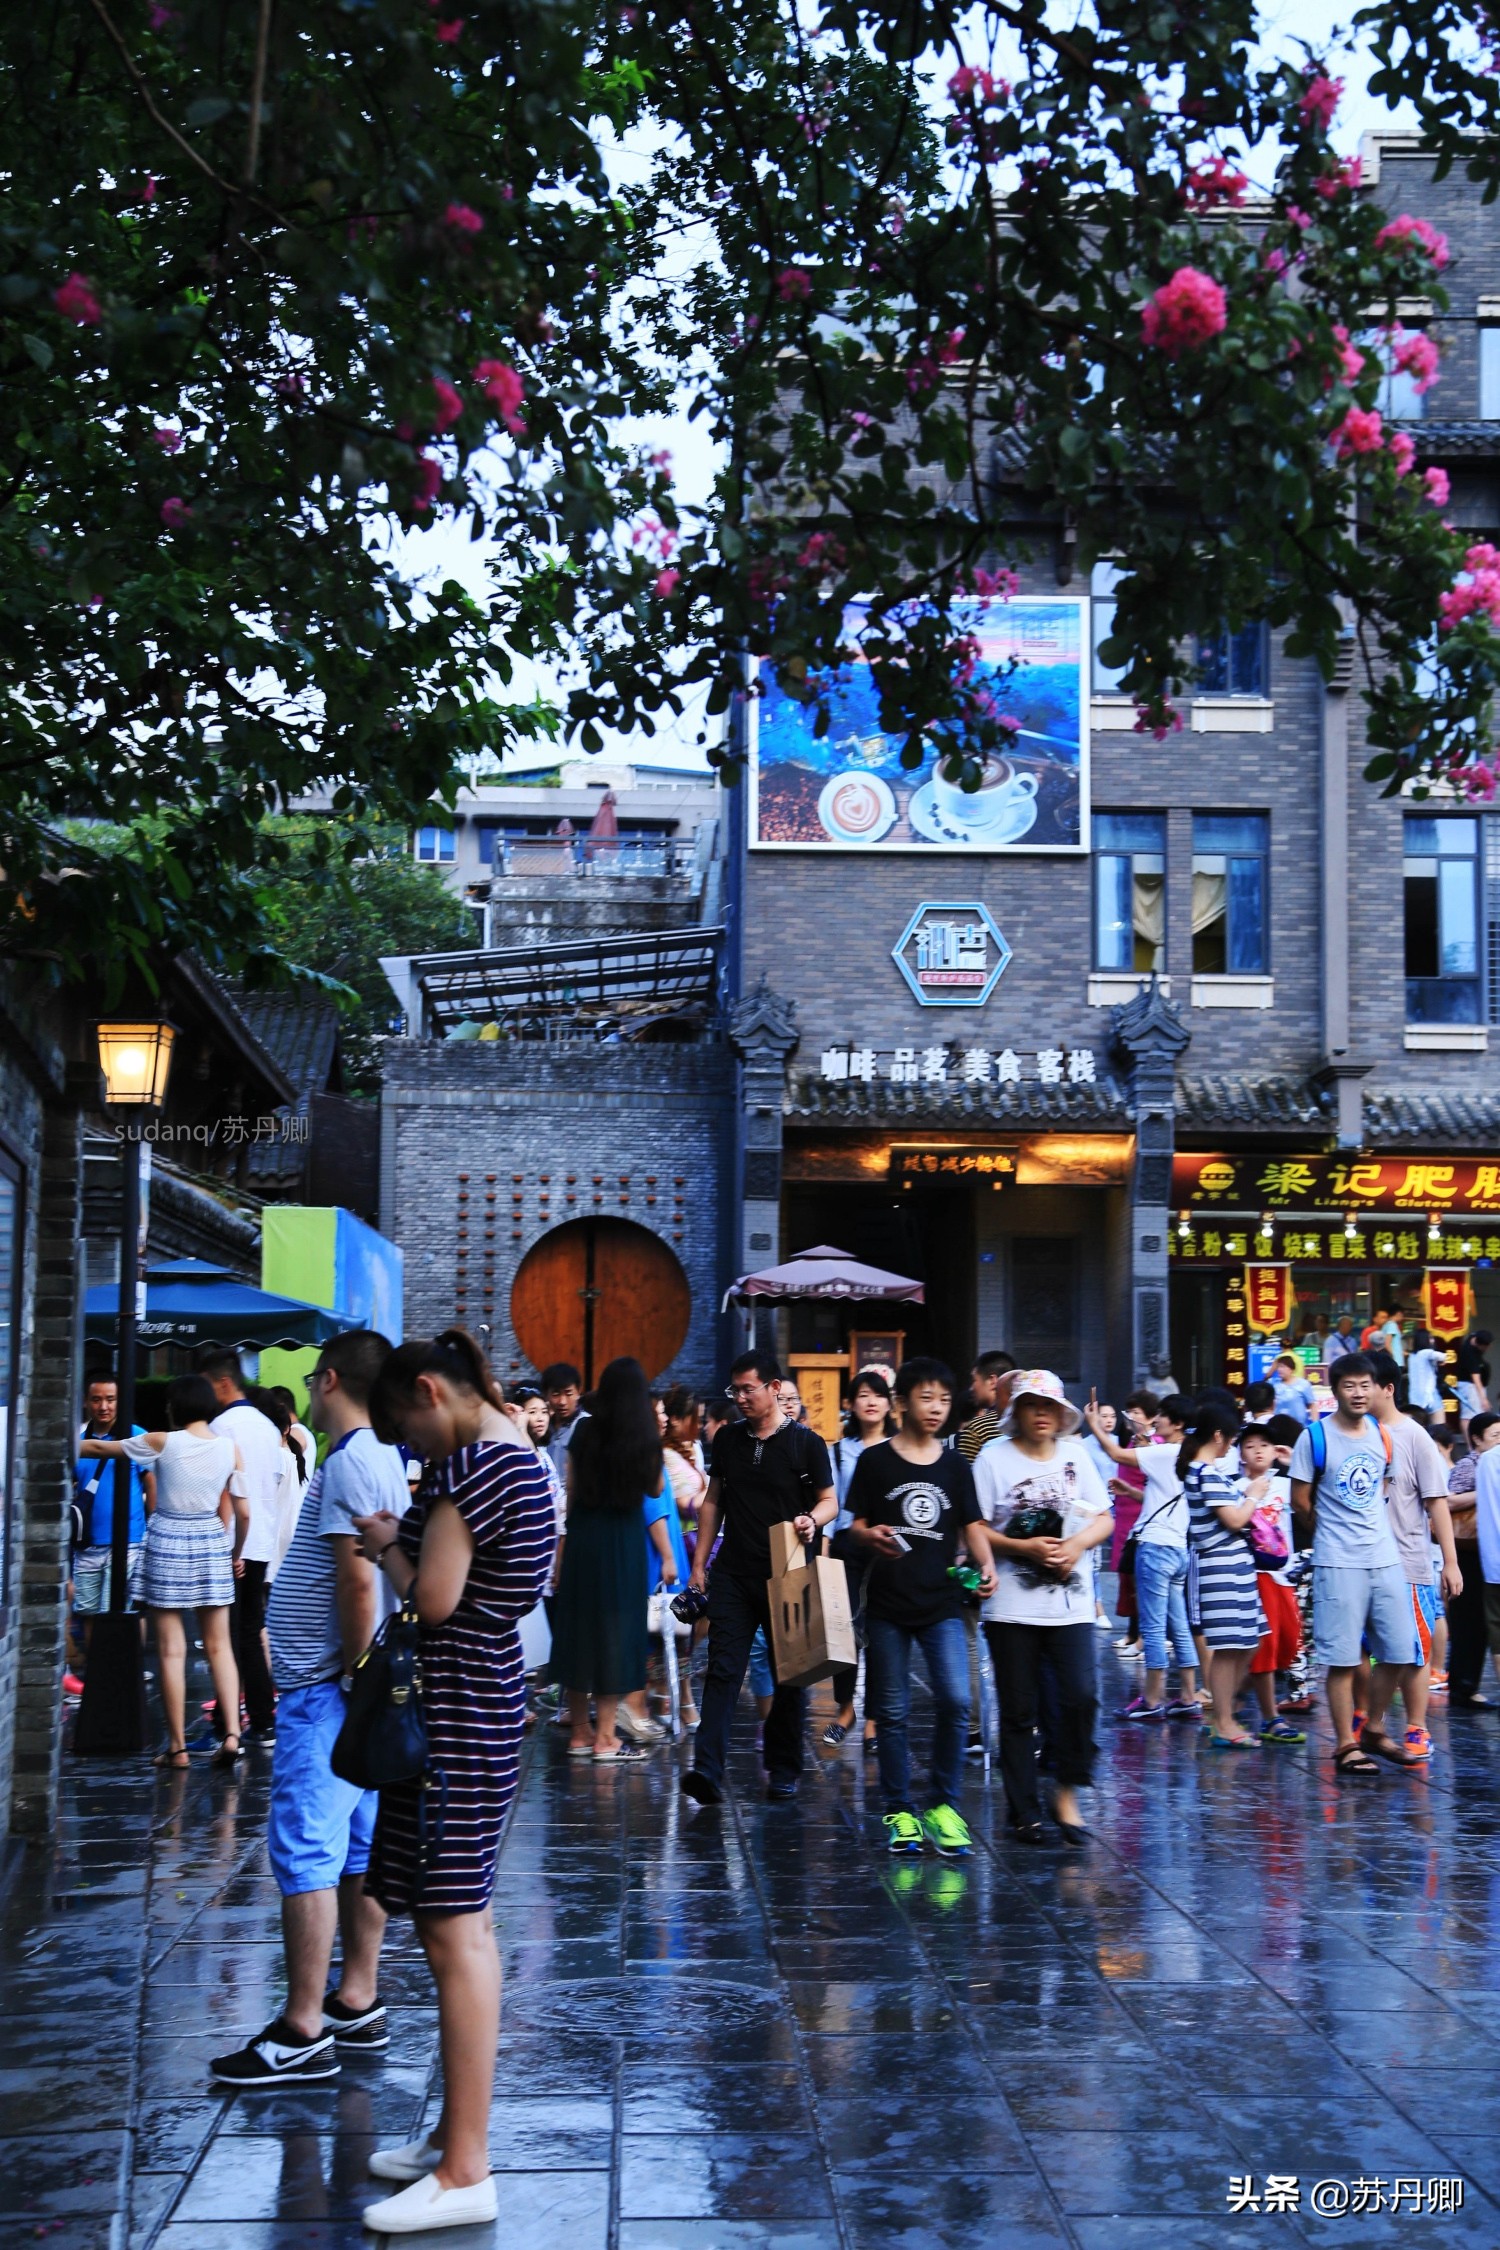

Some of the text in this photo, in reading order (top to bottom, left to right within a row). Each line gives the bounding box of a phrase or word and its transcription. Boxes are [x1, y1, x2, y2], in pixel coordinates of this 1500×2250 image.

[821, 1047, 1097, 1083] 咖啡 品茗 美食 客栈
[1268, 1196, 1500, 1209] Mr Liang's Gluten Fre
[1227, 1232, 1248, 1256] 面
[1253, 1231, 1274, 1257] 饭
[1283, 1232, 1322, 1258] 烧菜
[1328, 1232, 1367, 1259] 冒菜
[1373, 1231, 1420, 1260] 锅魁
[1258, 1269, 1279, 1319] 担担面
[1434, 1278, 1459, 1322] 锅魁
